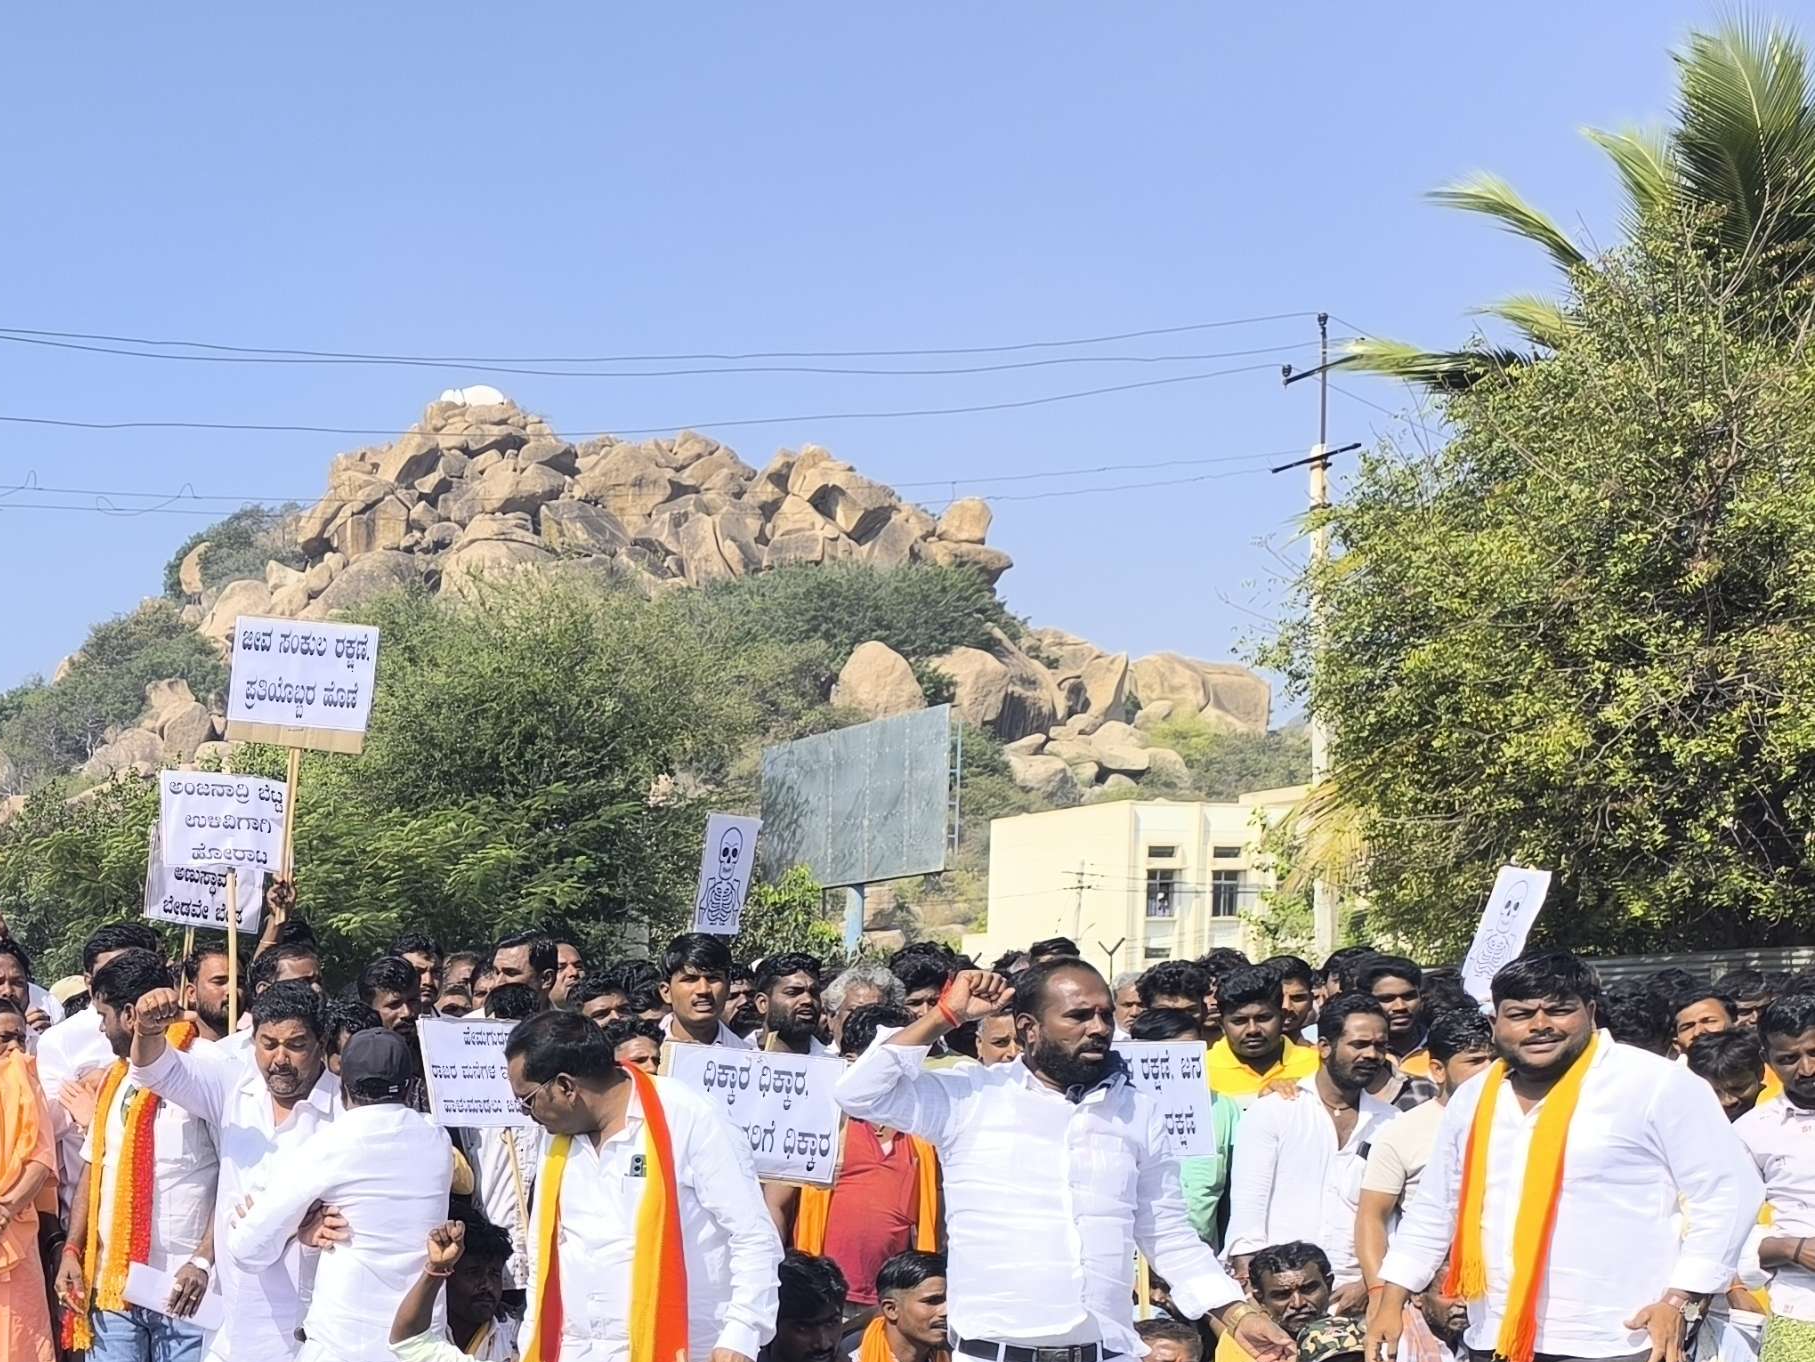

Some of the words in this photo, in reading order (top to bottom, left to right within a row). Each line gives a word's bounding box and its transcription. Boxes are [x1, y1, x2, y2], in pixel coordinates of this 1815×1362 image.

[242, 627, 273, 651] ಜೀವ
[279, 629, 327, 656] ಸಂಕುಲ
[244, 675, 317, 719] ಪ್ರತಿಯೊಬ್ಬರ
[323, 681, 359, 708] ಹೊಣೆ
[169, 780, 250, 804] ಅಂಜನಾದ್ರಿ
[258, 784, 283, 813] ಬೆಟ್ಟ
[185, 813, 272, 834] ಉಳಿವಿಗಾಗಿ
[191, 843, 268, 864] ಹೋರಾಟ
[174, 866, 237, 896] ಅಣುಸ್ಥಾವ
[163, 895, 209, 919] ಬೇಡವೇ
[703, 1059, 752, 1105] ಧಿಕ್ಕಾರ
[784, 1128, 831, 1171] ಧಿಕ್ಕಾರ
